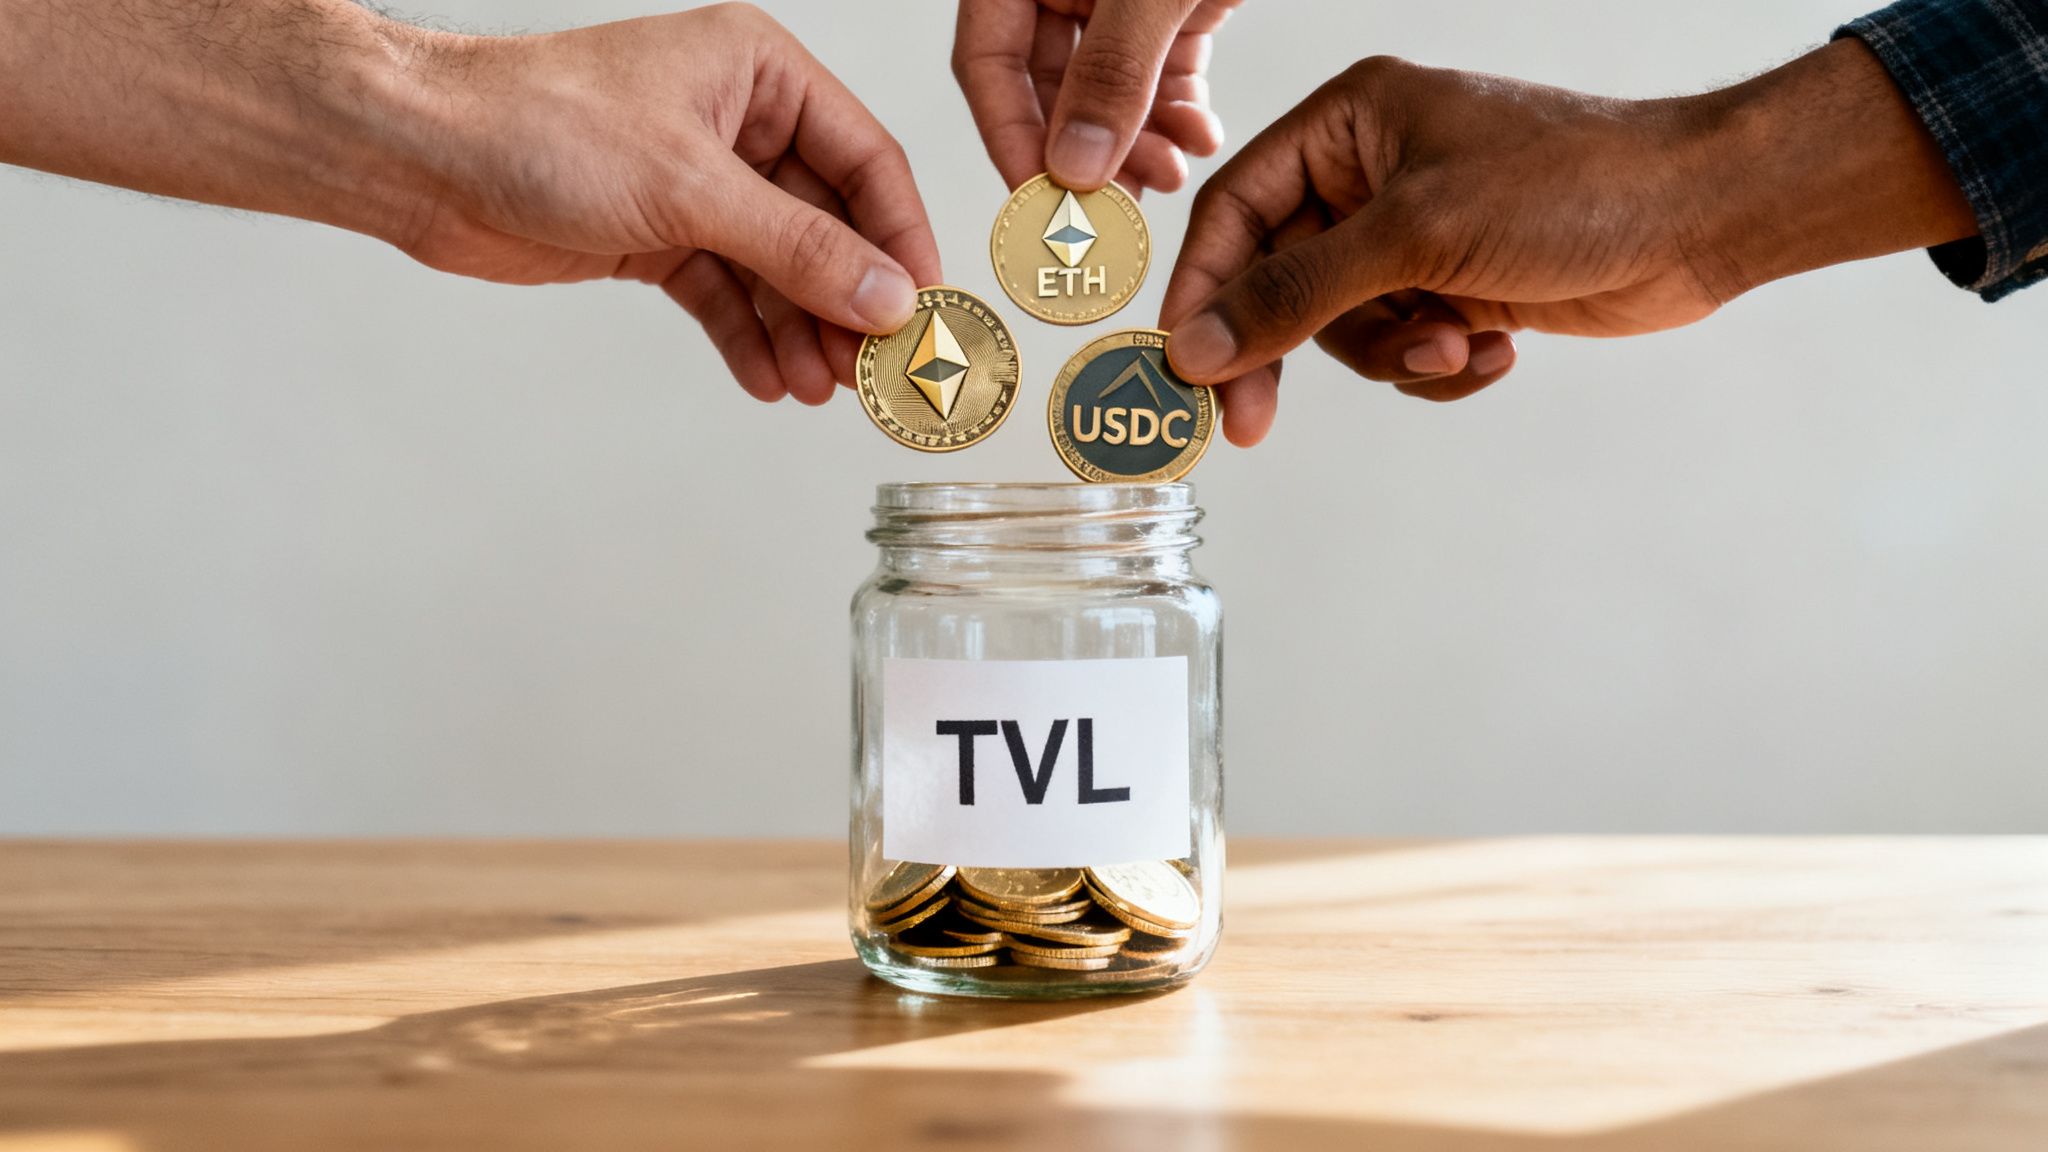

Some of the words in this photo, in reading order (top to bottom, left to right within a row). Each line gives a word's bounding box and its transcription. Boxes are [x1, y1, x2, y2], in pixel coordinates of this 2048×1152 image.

[1038, 266, 1106, 297] ETH
[1072, 405, 1191, 448] USDC
[936, 718, 1130, 805] TVL
